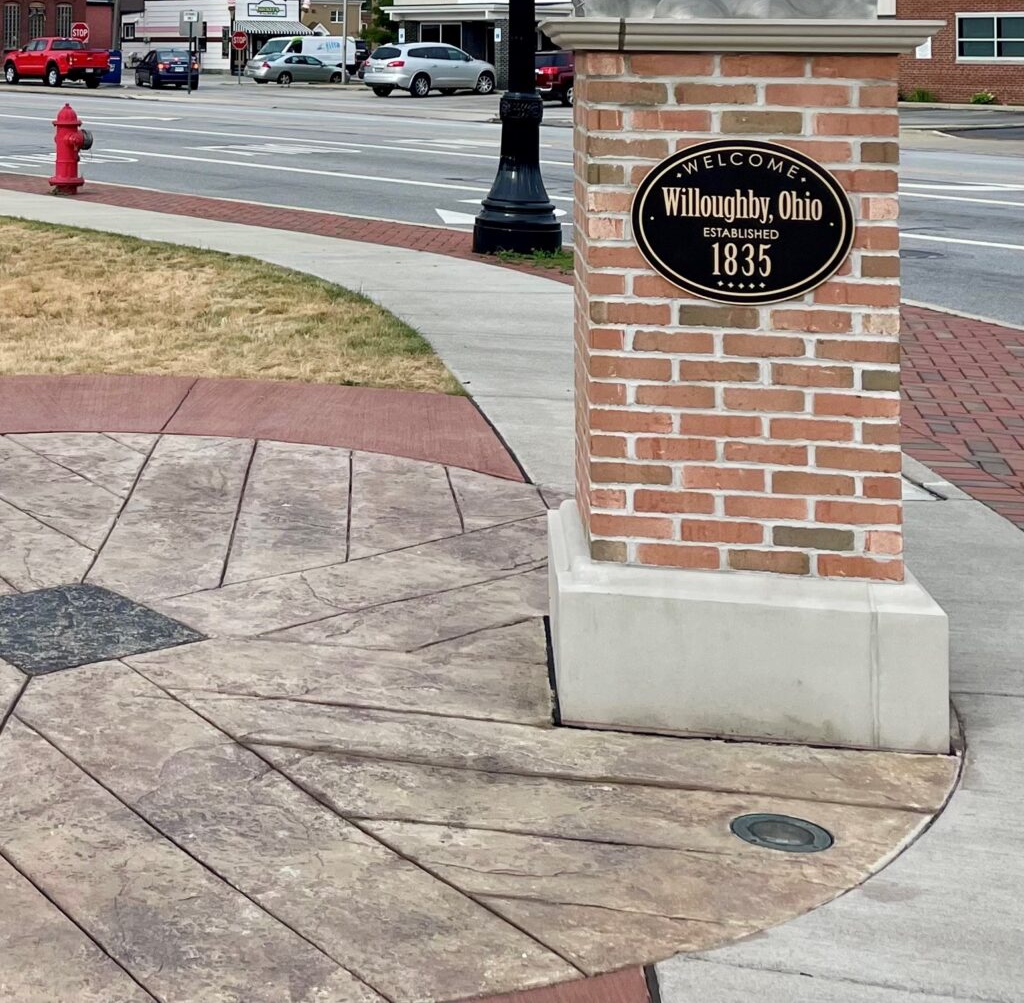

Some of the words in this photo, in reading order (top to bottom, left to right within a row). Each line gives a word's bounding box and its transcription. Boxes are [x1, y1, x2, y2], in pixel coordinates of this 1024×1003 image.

[72, 27, 88, 37] STOP
[232, 35, 247, 45] STOP
[682, 152, 800, 180] WELCOME
[662, 186, 774, 224] Willoughby,
[778, 190, 823, 221] Ohio
[703, 227, 779, 240] ESTABLISHED
[711, 242, 772, 277] 1835
